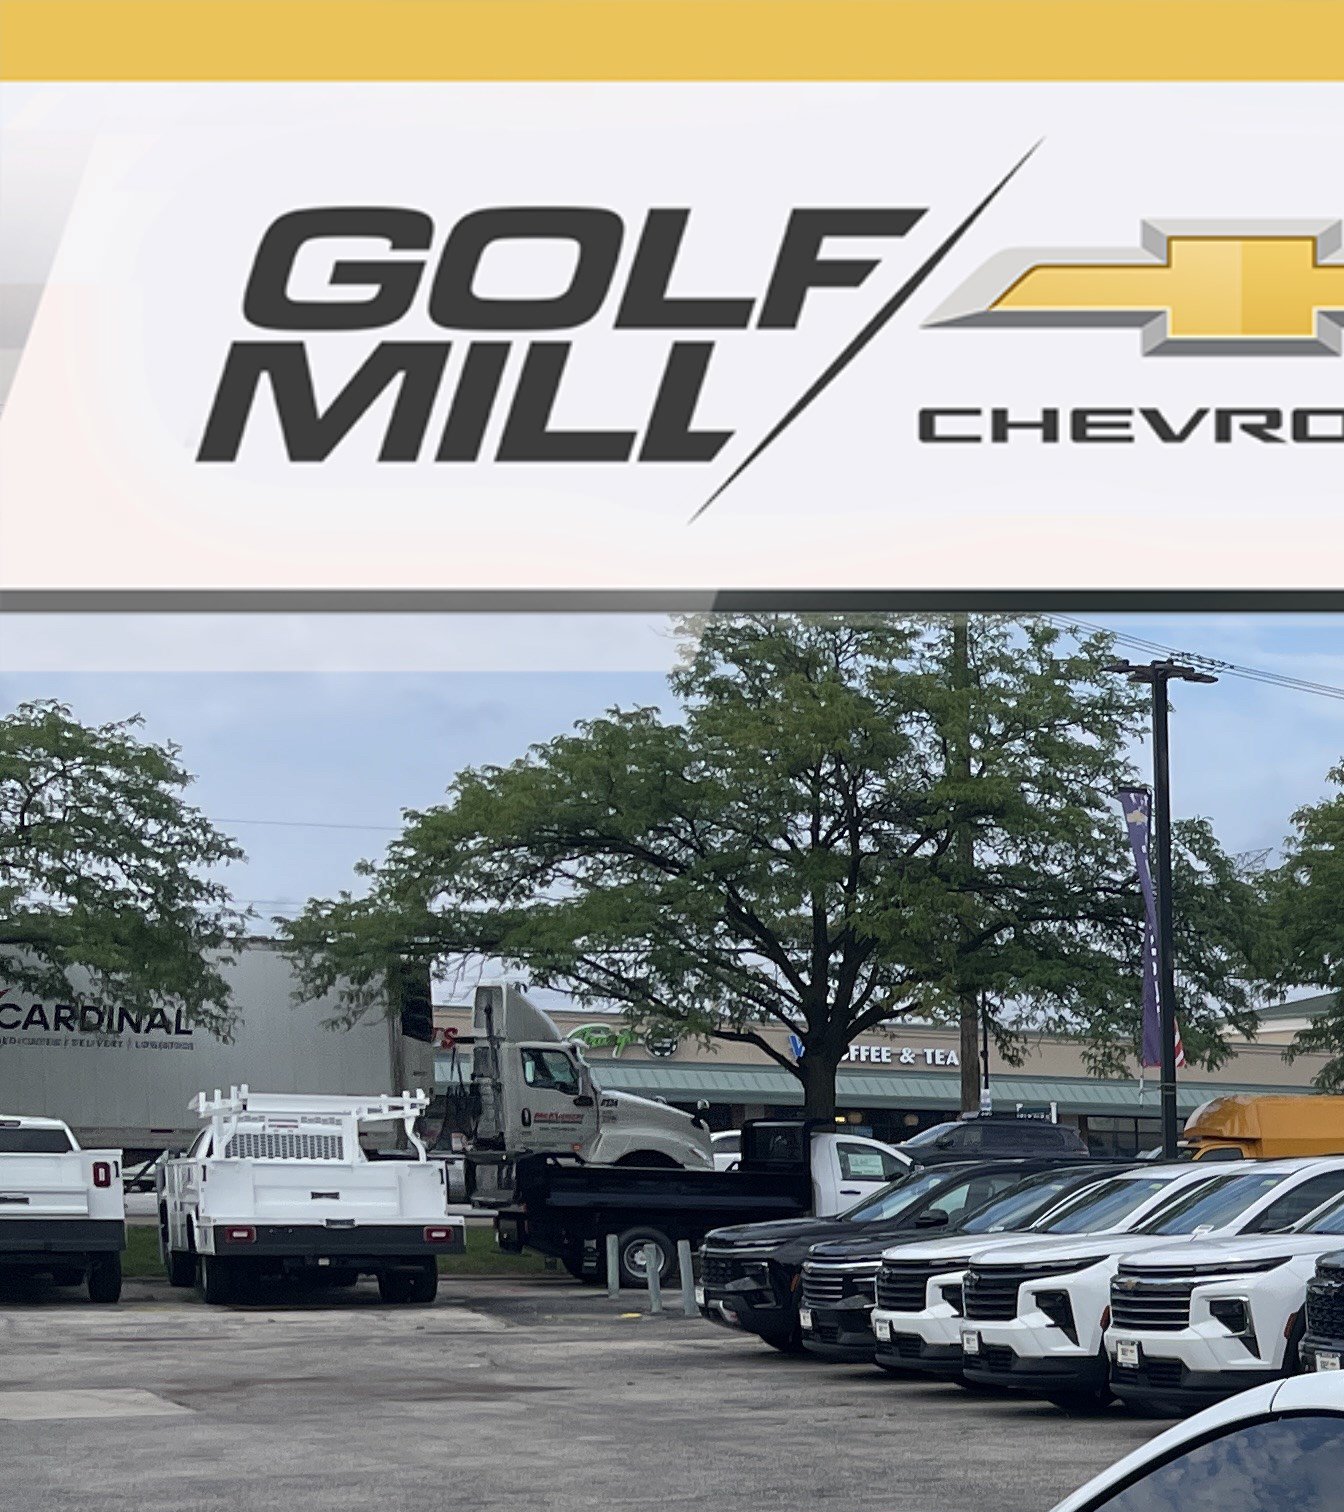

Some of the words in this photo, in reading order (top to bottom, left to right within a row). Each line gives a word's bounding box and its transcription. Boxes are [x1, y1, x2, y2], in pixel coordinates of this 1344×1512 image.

[0, 1003, 193, 1035] CARDINAL
[900, 1047, 915, 1064] &
[924, 1048, 960, 1066] TEA
